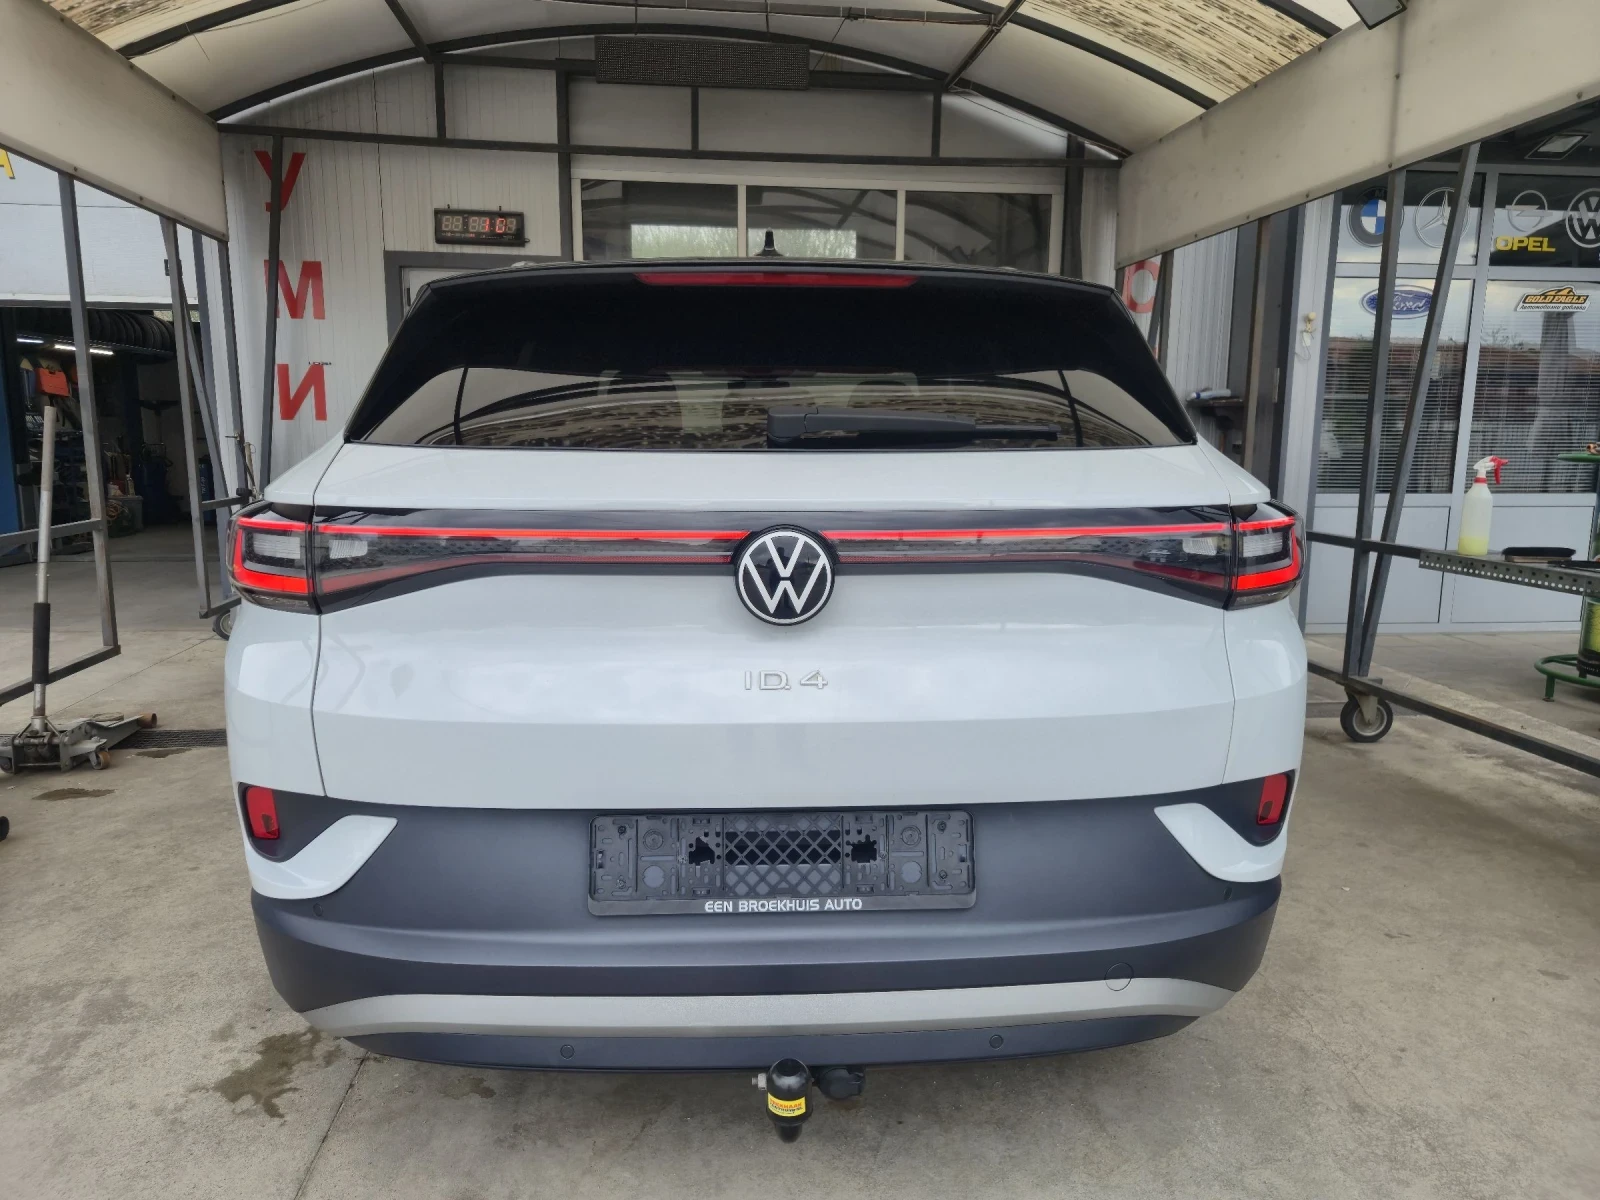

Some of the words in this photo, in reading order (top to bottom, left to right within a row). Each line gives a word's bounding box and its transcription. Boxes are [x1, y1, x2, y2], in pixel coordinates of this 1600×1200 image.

[1496, 236, 1556, 252] OPEL
[1525, 295, 1553, 303] GOLD
[1552, 295, 1587, 303] EAGLE
[704, 901, 733, 913] EEN
[738, 899, 820, 912] BROEKHUIS
[824, 898, 863, 911] AUTO
